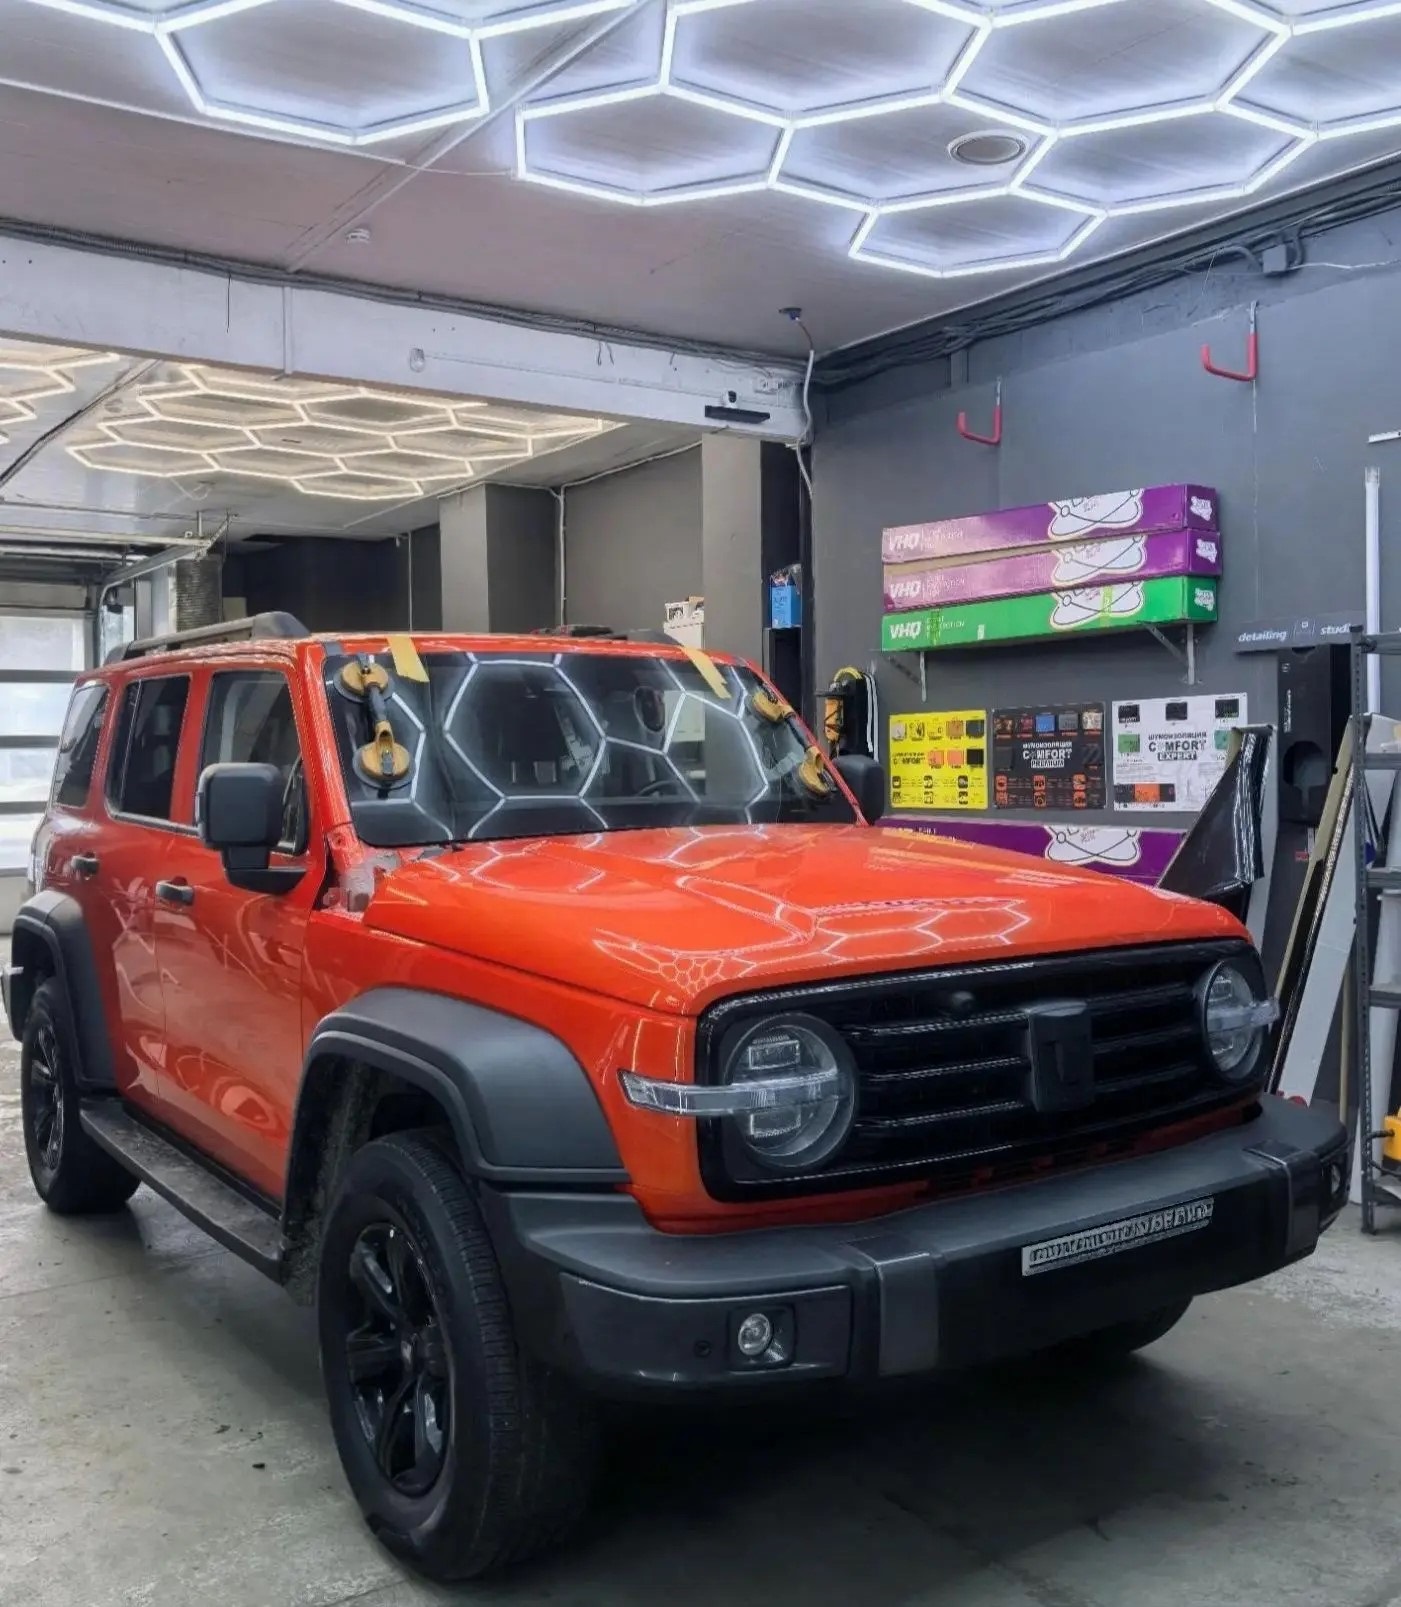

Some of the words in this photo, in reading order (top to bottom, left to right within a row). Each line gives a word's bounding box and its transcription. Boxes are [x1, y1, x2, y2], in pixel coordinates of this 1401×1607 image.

[889, 580, 921, 599] VHQ
[889, 620, 922, 639] VHQ
[1238, 629, 1287, 642] detailing
[1320, 622, 1351, 636] studi
[1148, 739, 1207, 752] CMFORT
[1159, 751, 1197, 761] EXPERT
